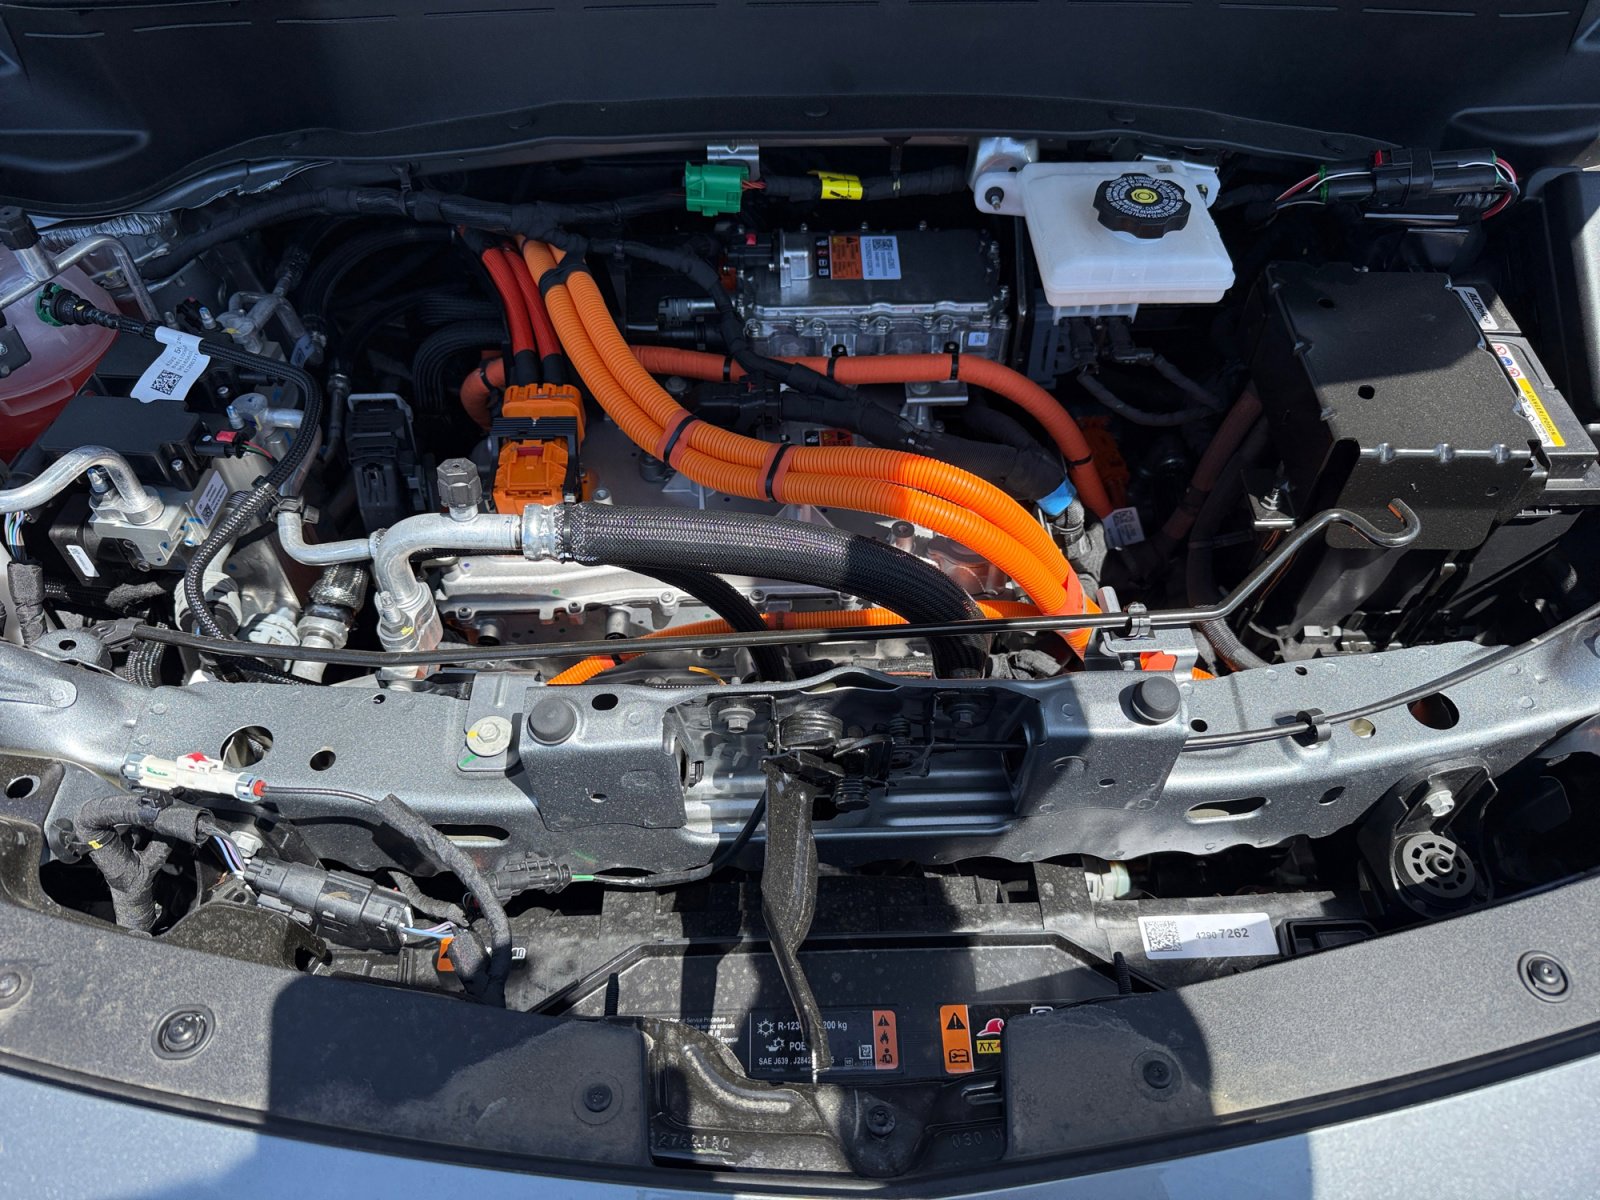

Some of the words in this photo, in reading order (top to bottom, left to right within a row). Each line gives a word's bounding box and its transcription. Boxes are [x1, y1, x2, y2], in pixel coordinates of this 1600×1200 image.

[778, 1021, 800, 1031] R-123
[837, 1021, 848, 1031] kg
[789, 1041, 807, 1051] POE
[758, 1057, 773, 1065] SAE
[773, 1057, 789, 1065] J639
